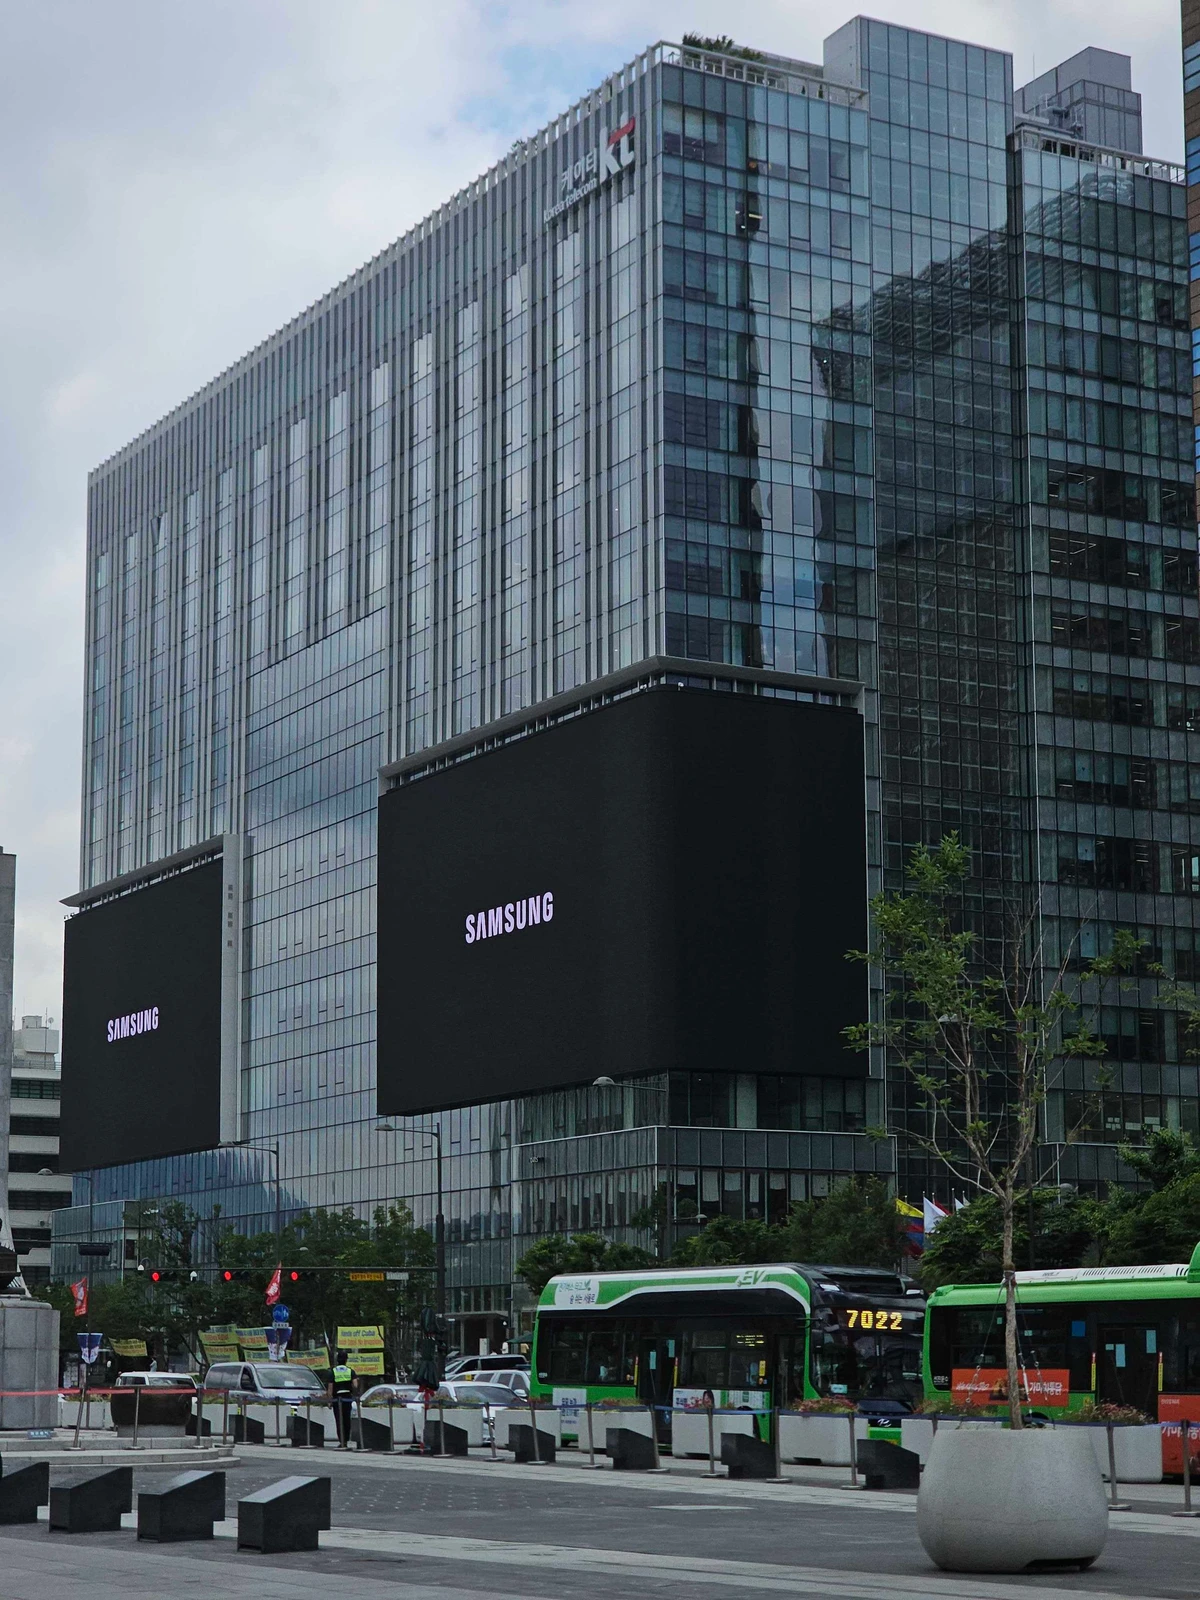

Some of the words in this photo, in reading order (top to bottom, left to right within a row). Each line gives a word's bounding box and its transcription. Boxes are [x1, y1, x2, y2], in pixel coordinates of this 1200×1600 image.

[599, 111, 636, 183] kt
[560, 147, 598, 191] 케이티
[465, 891, 554, 944] SAMSUNG
[107, 1006, 159, 1043] SAMSUNG
[738, 1271, 765, 1287] EV
[846, 1310, 902, 1330] 7022
